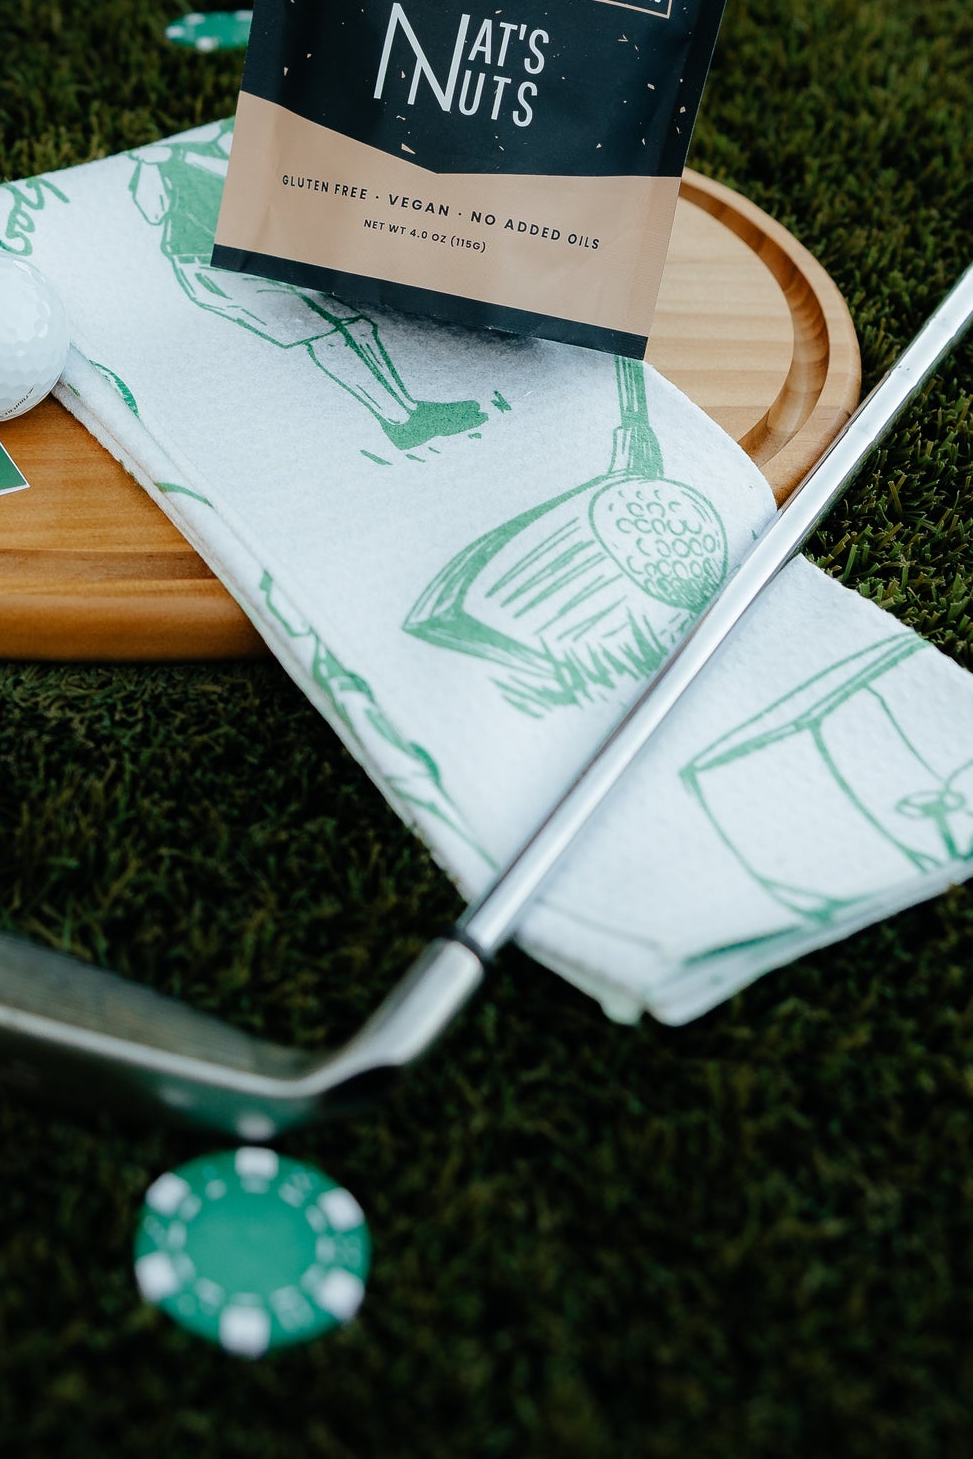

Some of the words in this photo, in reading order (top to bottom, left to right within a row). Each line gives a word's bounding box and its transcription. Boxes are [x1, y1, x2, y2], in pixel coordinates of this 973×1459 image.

[373, 2, 550, 113] NAT'S
[407, 56, 538, 128] NUTS
[282, 174, 329, 193] GLUTEN
[334, 183, 368, 200] FREE
[388, 193, 450, 217] VEGAN
[470, 210, 497, 226] NO
[504, 218, 561, 241] ADDED
[567, 233, 600, 250] OILS
[363, 219, 385, 231] NET
[388, 224, 407, 236] WT
[409, 228, 428, 239] 4.0
[431, 233, 447, 244] OZ
[450, 235, 486, 253] (115G)
